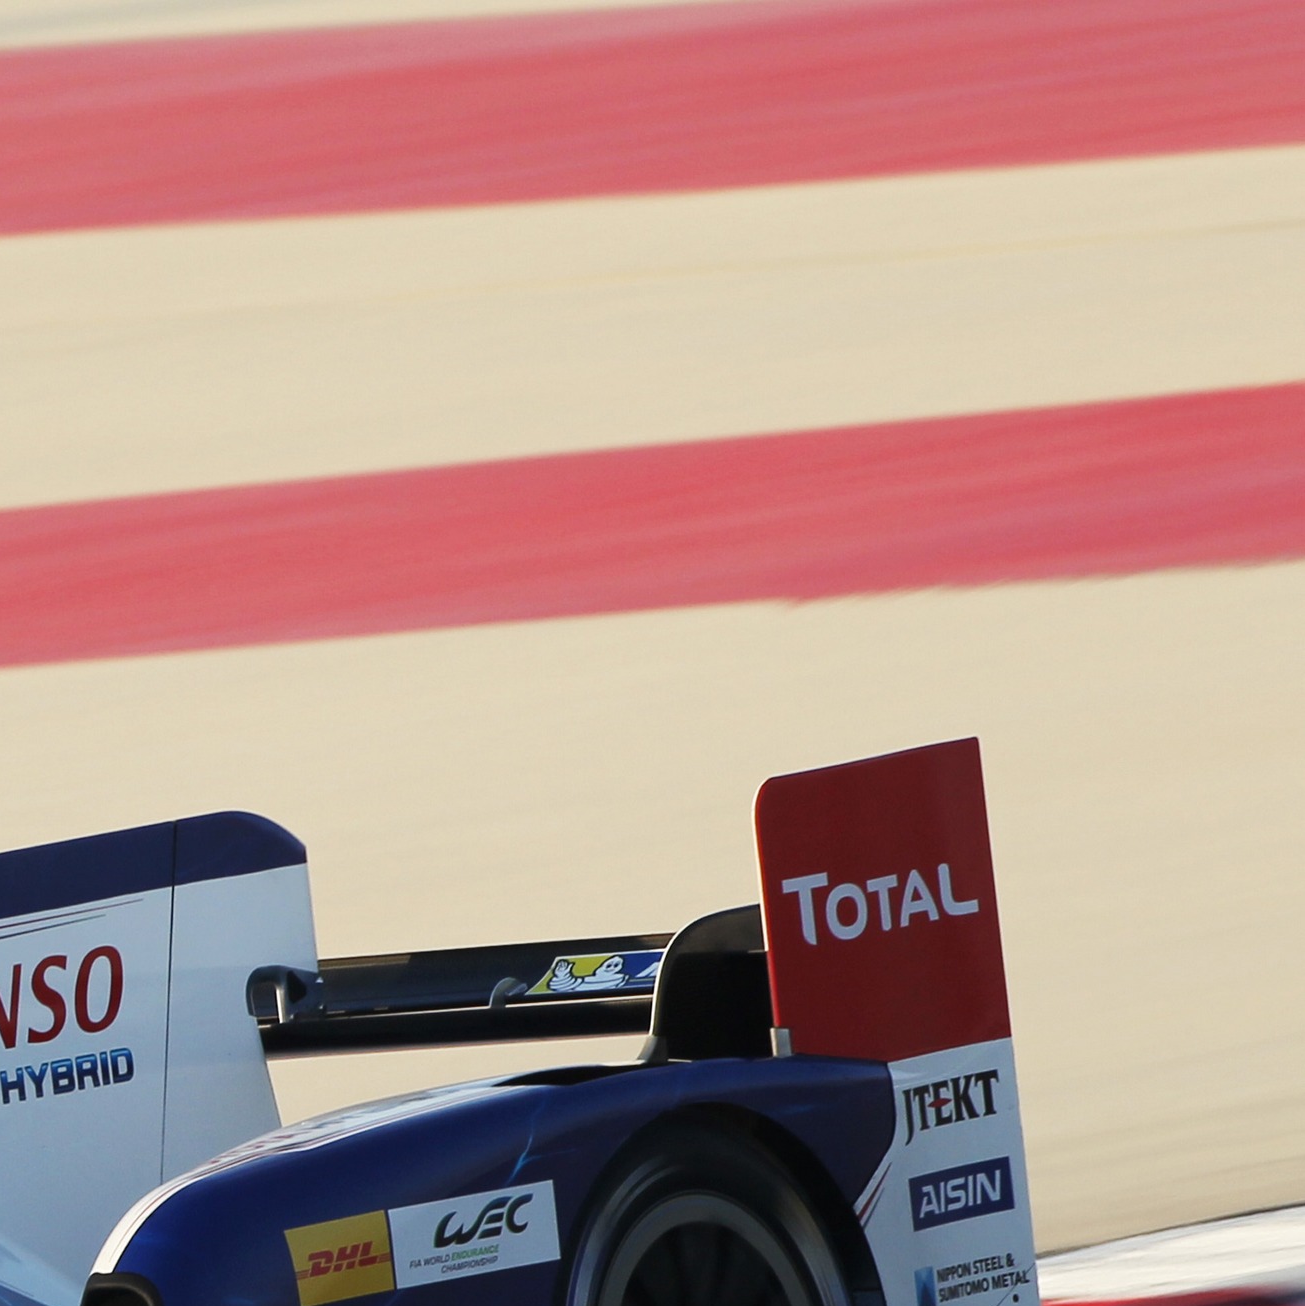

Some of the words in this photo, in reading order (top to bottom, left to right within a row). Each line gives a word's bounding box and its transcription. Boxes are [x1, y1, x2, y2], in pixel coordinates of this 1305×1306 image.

[781, 863, 979, 945] TOTAL
[0, 1047, 135, 1104] HYBRID
[902, 1069, 1000, 1147] JTEKT
[919, 1169, 1001, 1218] AISIN
[433, 1193, 533, 1248] WEC
[308, 1240, 378, 1278] DHL
[409, 1258, 422, 1269] FIA
[423, 1253, 450, 1267] WORLD
[441, 1255, 498, 1274] CHAMPIONSHIP
[936, 1262, 971, 1283] NIPPON
[973, 1255, 1004, 1275] STEEL
[1005, 1253, 1015, 1267] &
[938, 1278, 990, 1303] SUMITOMO
[992, 1270, 1030, 1290] METAL
